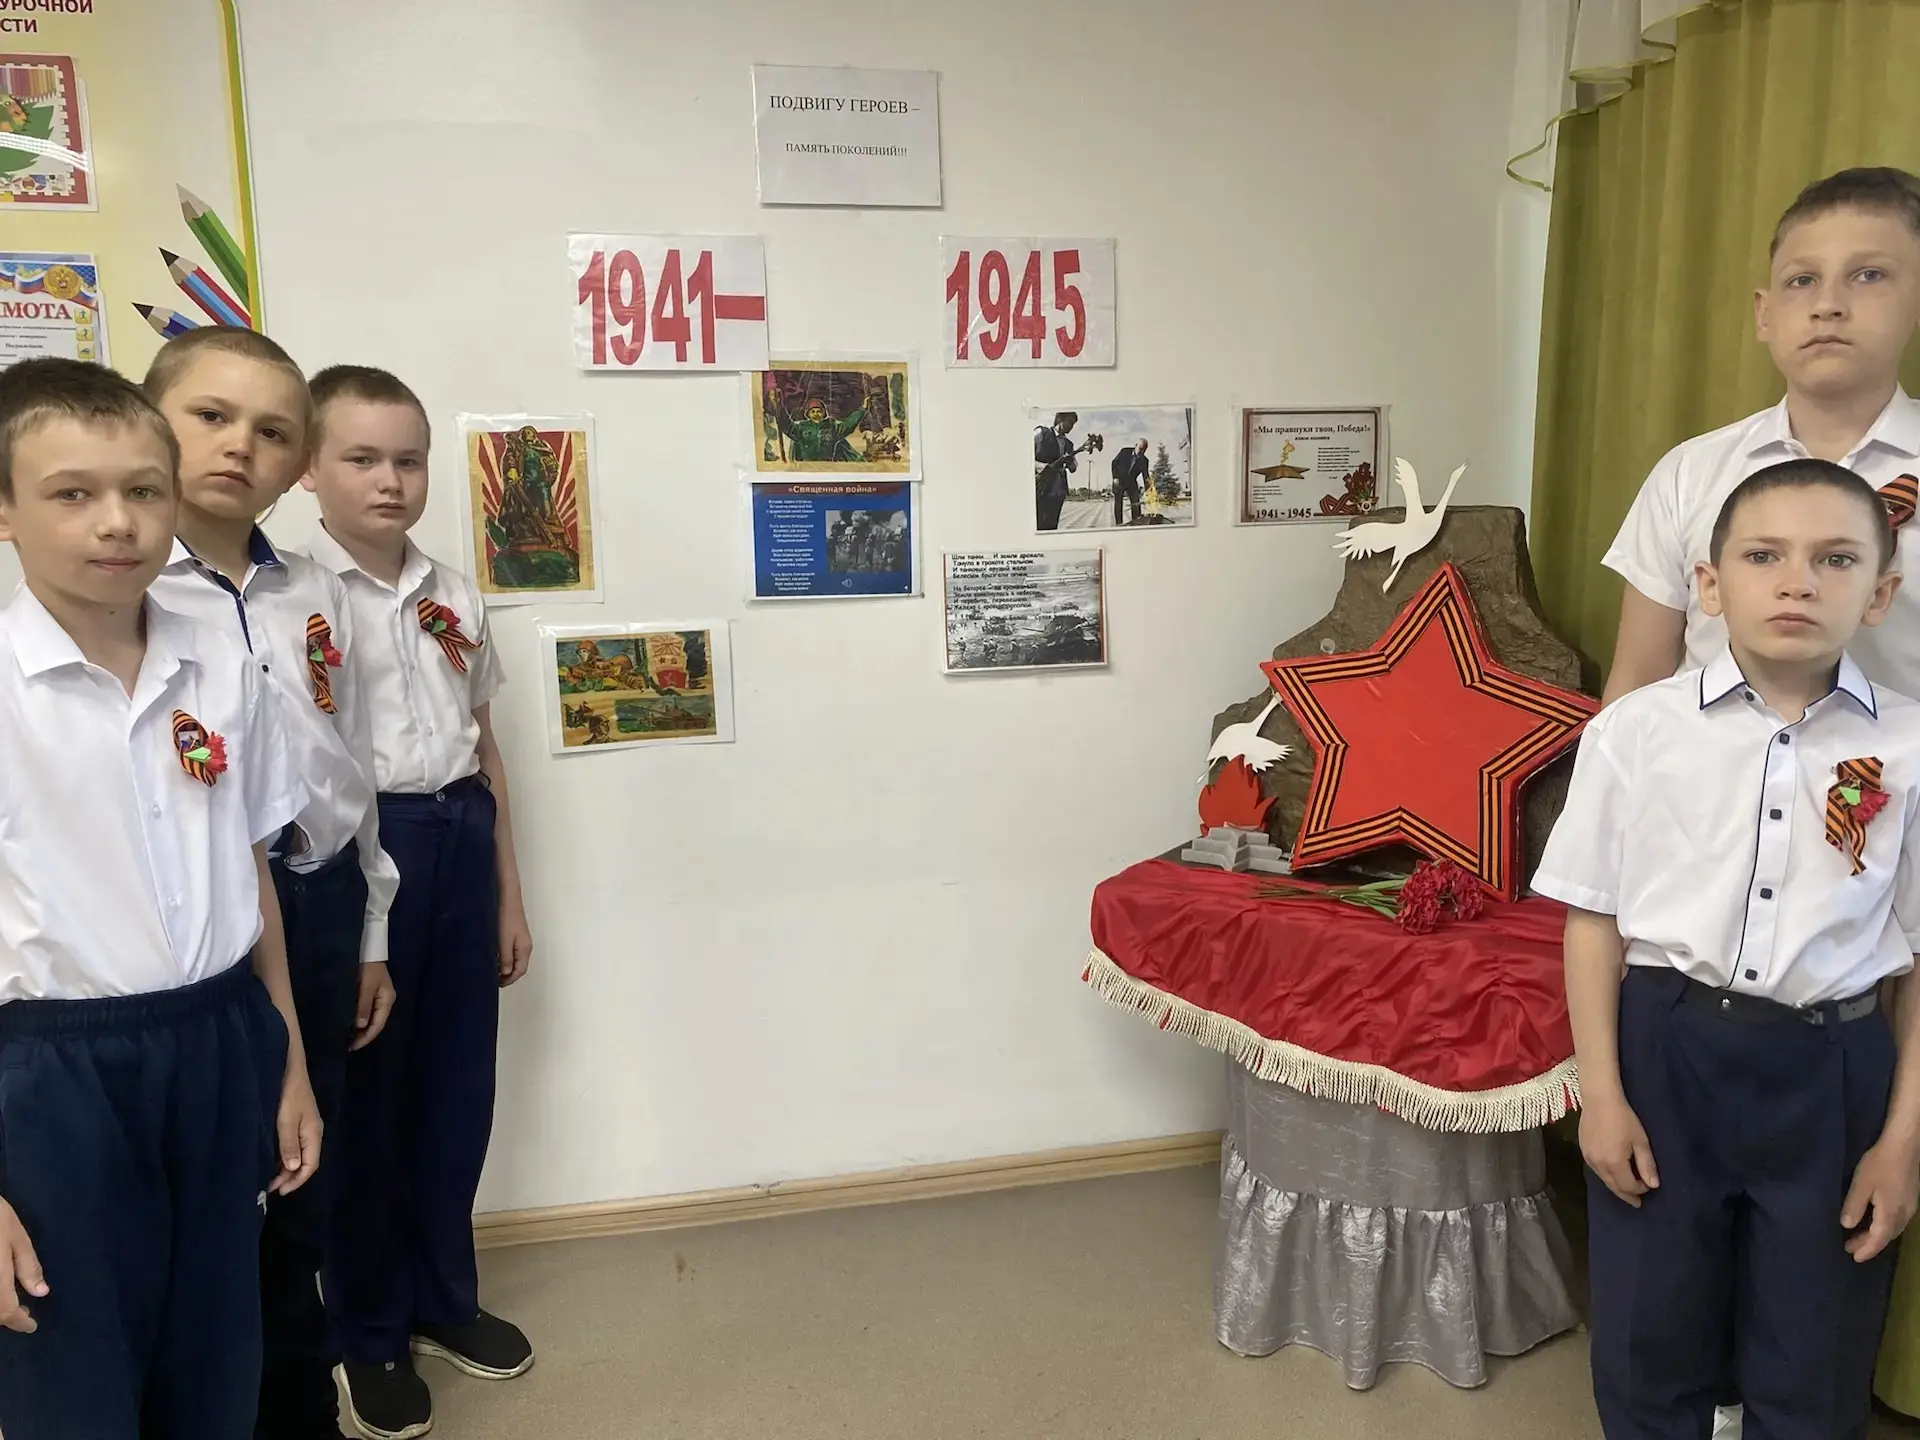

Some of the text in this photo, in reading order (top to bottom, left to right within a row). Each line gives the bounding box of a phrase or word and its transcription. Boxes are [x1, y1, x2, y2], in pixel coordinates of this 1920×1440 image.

[770, 95, 845, 112] ПОДВИГУ
[850, 98, 908, 114] ГЕРОЕВ
[785, 142, 907, 156] ПАМЯТЬ ПОКОЛЕНИЙ!!!
[0, 302, 73, 320] МОТА
[946, 249, 1086, 361] 1945
[1275, 426, 1313, 434] правнуки
[788, 485, 877, 494] «Священная война»
[1256, 509, 1278, 518] 1941
[1287, 508, 1311, 518] 1945
